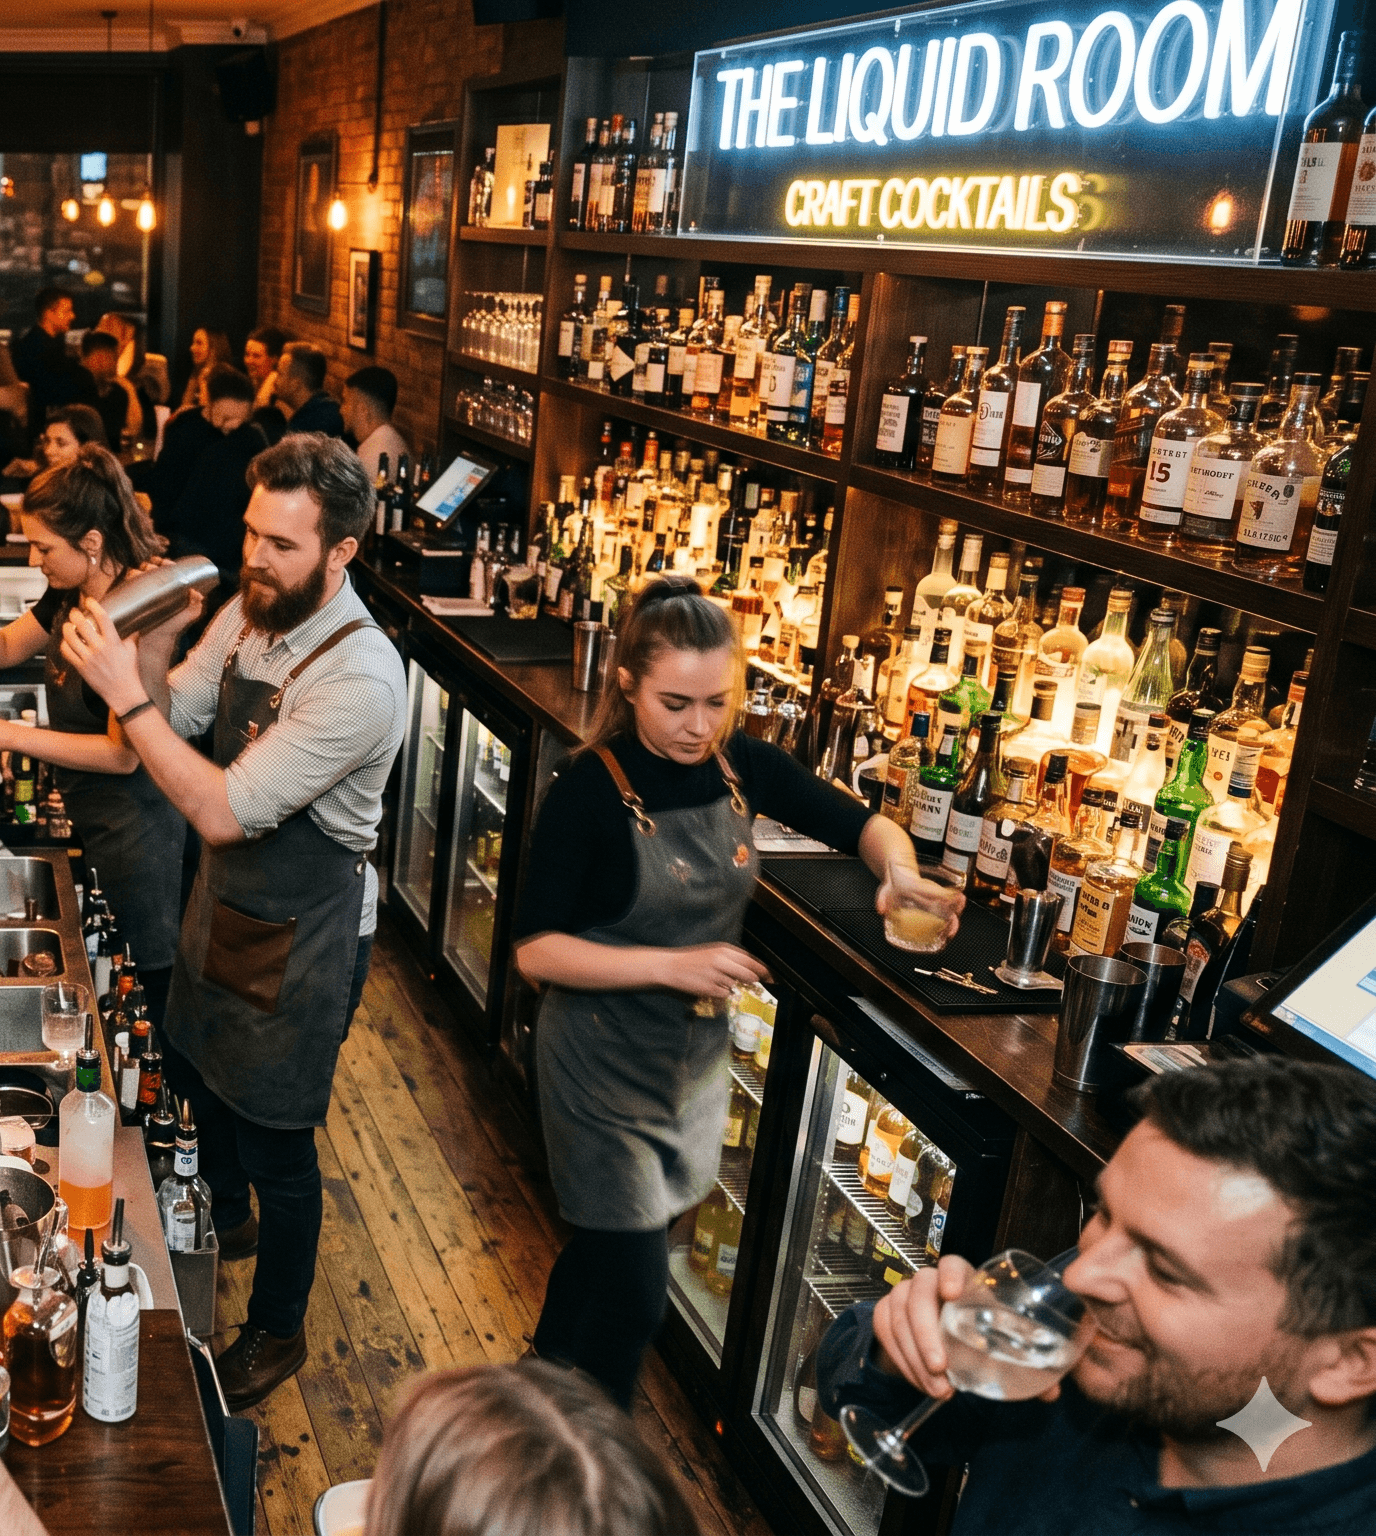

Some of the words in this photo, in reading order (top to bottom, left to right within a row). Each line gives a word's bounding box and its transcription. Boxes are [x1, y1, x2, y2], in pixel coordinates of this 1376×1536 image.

[716, 59, 805, 150] THE
[805, 32, 1002, 146] LIQUID
[1013, 0, 1303, 131] ROOM
[784, 178, 881, 227] CRAFT
[879, 171, 1083, 232] COCKTAILS
[1149, 460, 1172, 483] 15
